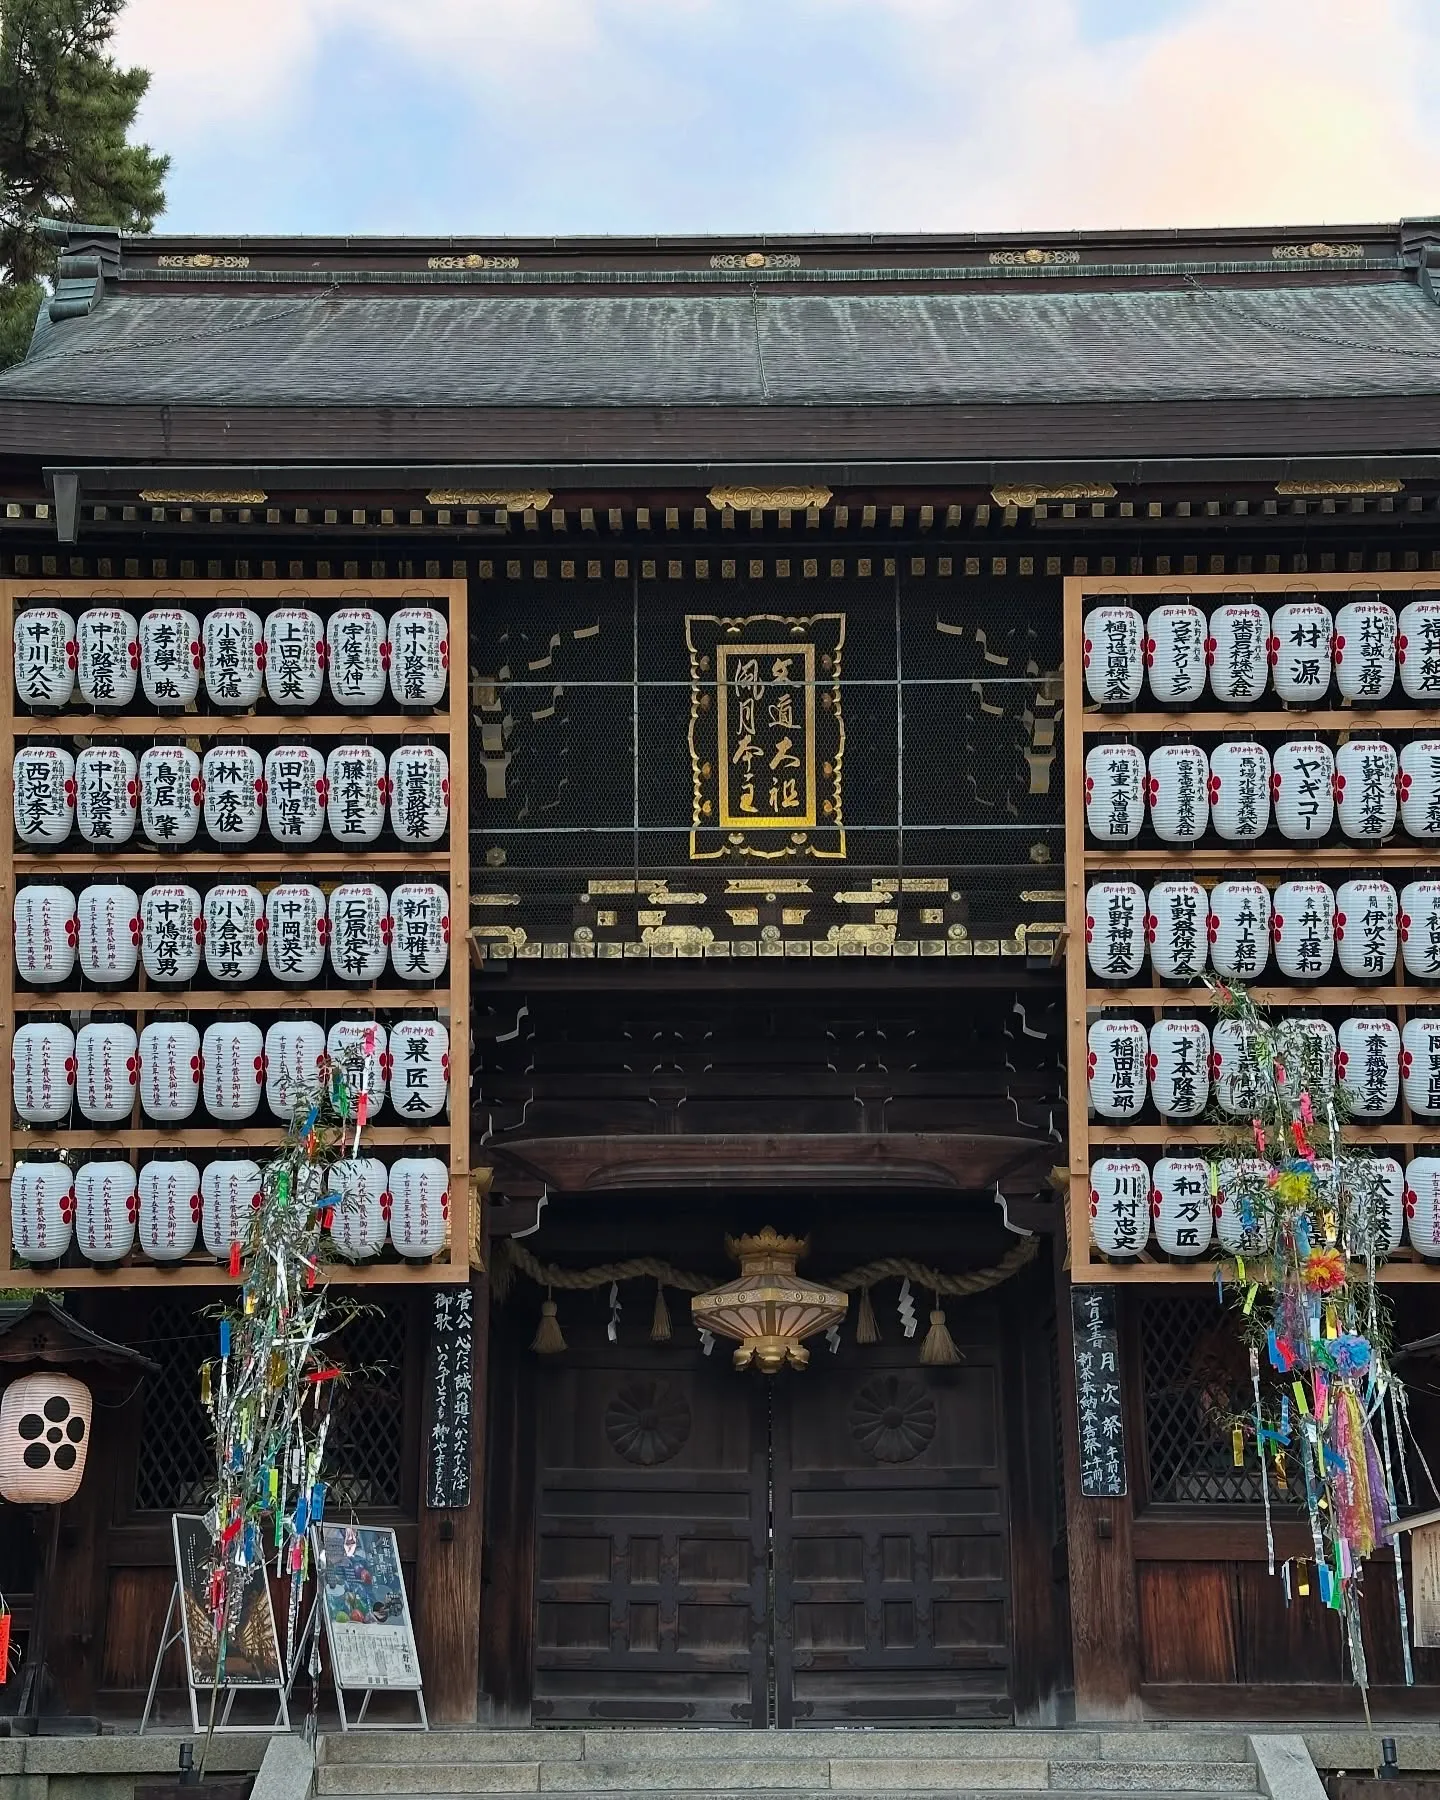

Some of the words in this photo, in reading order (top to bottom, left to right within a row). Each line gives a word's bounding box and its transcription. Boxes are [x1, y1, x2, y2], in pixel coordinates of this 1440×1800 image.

[27, 623, 53, 699] 中川久公
[89, 622, 116, 699] 中小路宗俊
[342, 623, 365, 696] 宇佐美伸二
[404, 623, 427, 699] 中小路宗隆
[1227, 619, 1255, 697] 柴田石材株式会社
[1289, 623, 1321, 685] 材源
[1357, 616, 1384, 695] 北村誠工務店
[25, 763, 54, 835] 西池季久
[88, 761, 114, 838] 中小路宗廣
[341, 760, 366, 834] 藤森長正
[1293, 758, 1321, 830] ヤギコー
[154, 900, 180, 976] 中嶋保男
[217, 901, 243, 978] 小倉邦男
[280, 901, 304, 972] 中岡英文
[341, 900, 370, 976] 石原定祥
[403, 899, 430, 973] 新田雅美
[1169, 894, 1197, 975] 北野祭保存会
[1360, 910, 1386, 972] 伊吹文明
[401, 1037, 432, 1112] 菓匠会
[1111, 1177, 1139, 1250] 川村忠史
[1172, 1176, 1201, 1246] 和乃匠
